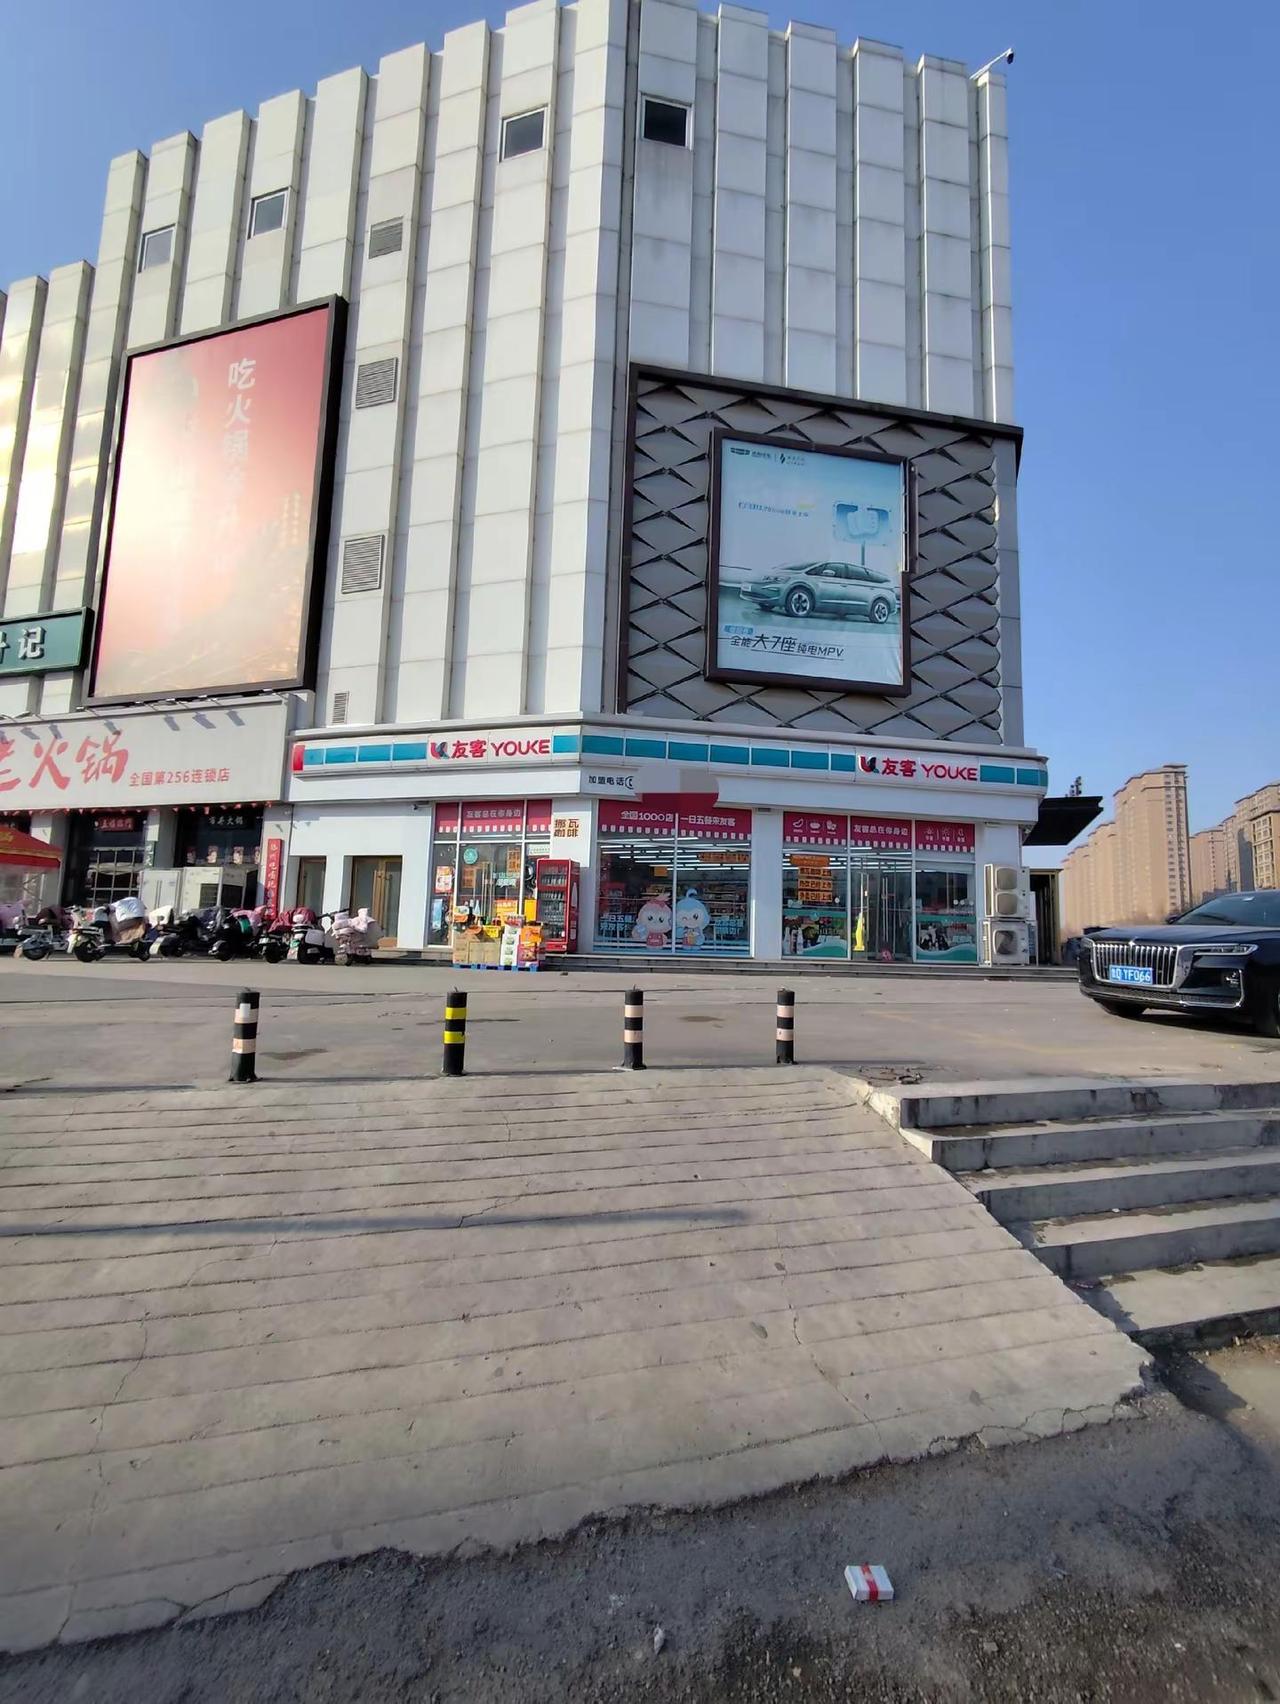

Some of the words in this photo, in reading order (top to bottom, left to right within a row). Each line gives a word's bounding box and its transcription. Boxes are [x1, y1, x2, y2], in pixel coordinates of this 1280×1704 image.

[451, 739, 487, 759] 友客
[490, 738, 551, 757] YOUKE
[881, 757, 917, 777] 友客
[921, 763, 978, 781] YOUKE
[129, 767, 231, 787] 全国第256连锁店
[588, 775, 625, 786] 加盟电话
[620, 810, 674, 823] 全国1000店
[553, 818, 580, 829] 挪瓦
[553, 828, 579, 838] 咖啡
